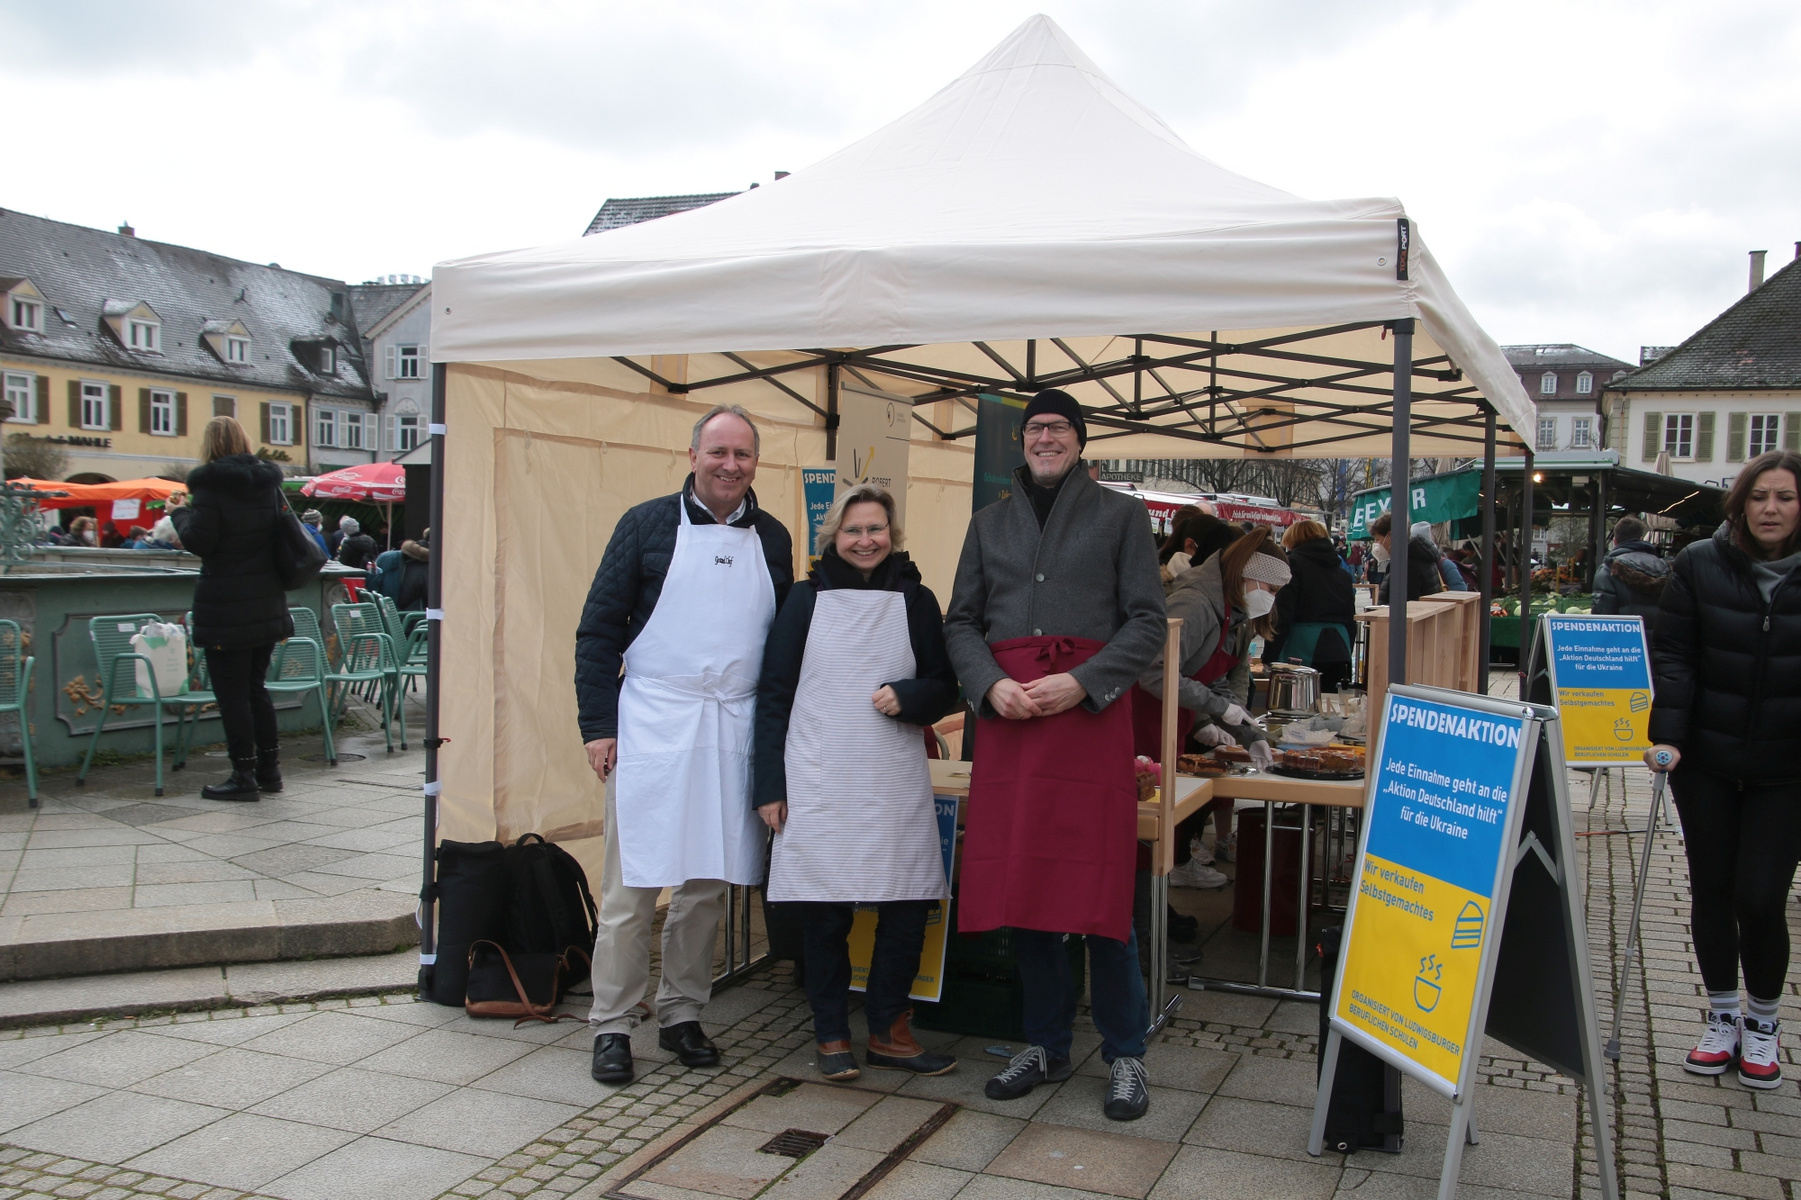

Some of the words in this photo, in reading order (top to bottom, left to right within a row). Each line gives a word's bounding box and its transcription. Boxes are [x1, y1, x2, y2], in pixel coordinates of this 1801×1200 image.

[1101, 473, 1141, 481] APOTHEKE
[1552, 621, 1640, 633] SPENDENAKTION
[1574, 645, 1605, 653] Einnahme
[1606, 646, 1620, 654] geht
[1584, 654, 1623, 662] Deutschland
[1391, 703, 1521, 749] SPENDENAKTION
[1385, 758, 1406, 775] Jede
[1407, 762, 1451, 787] Einnahme
[1452, 778, 1477, 795] geht
[1478, 784, 1491, 798] an
[1492, 785, 1507, 803] die
[1382, 780, 1416, 800] „Aktion
[1417, 788, 1476, 818] Deutschland
[1477, 804, 1503, 825] hilft“
[1400, 805, 1414, 822] für
[1415, 810, 1429, 827] die
[1430, 815, 1468, 840] Ukraine
[1364, 858, 1379, 876] Wir
[1380, 870, 1424, 894] verkaufen
[1360, 879, 1434, 922] Selbstgemachtes
[1349, 1003, 1389, 1033] BERUFLICHEN
[1389, 1025, 1418, 1050] SCHULEN
[1351, 989, 1390, 1017] ORGANISIERT
[1390, 1009, 1404, 1025] VON
[1404, 1017, 1460, 1056] LUDWIGSBURGER
